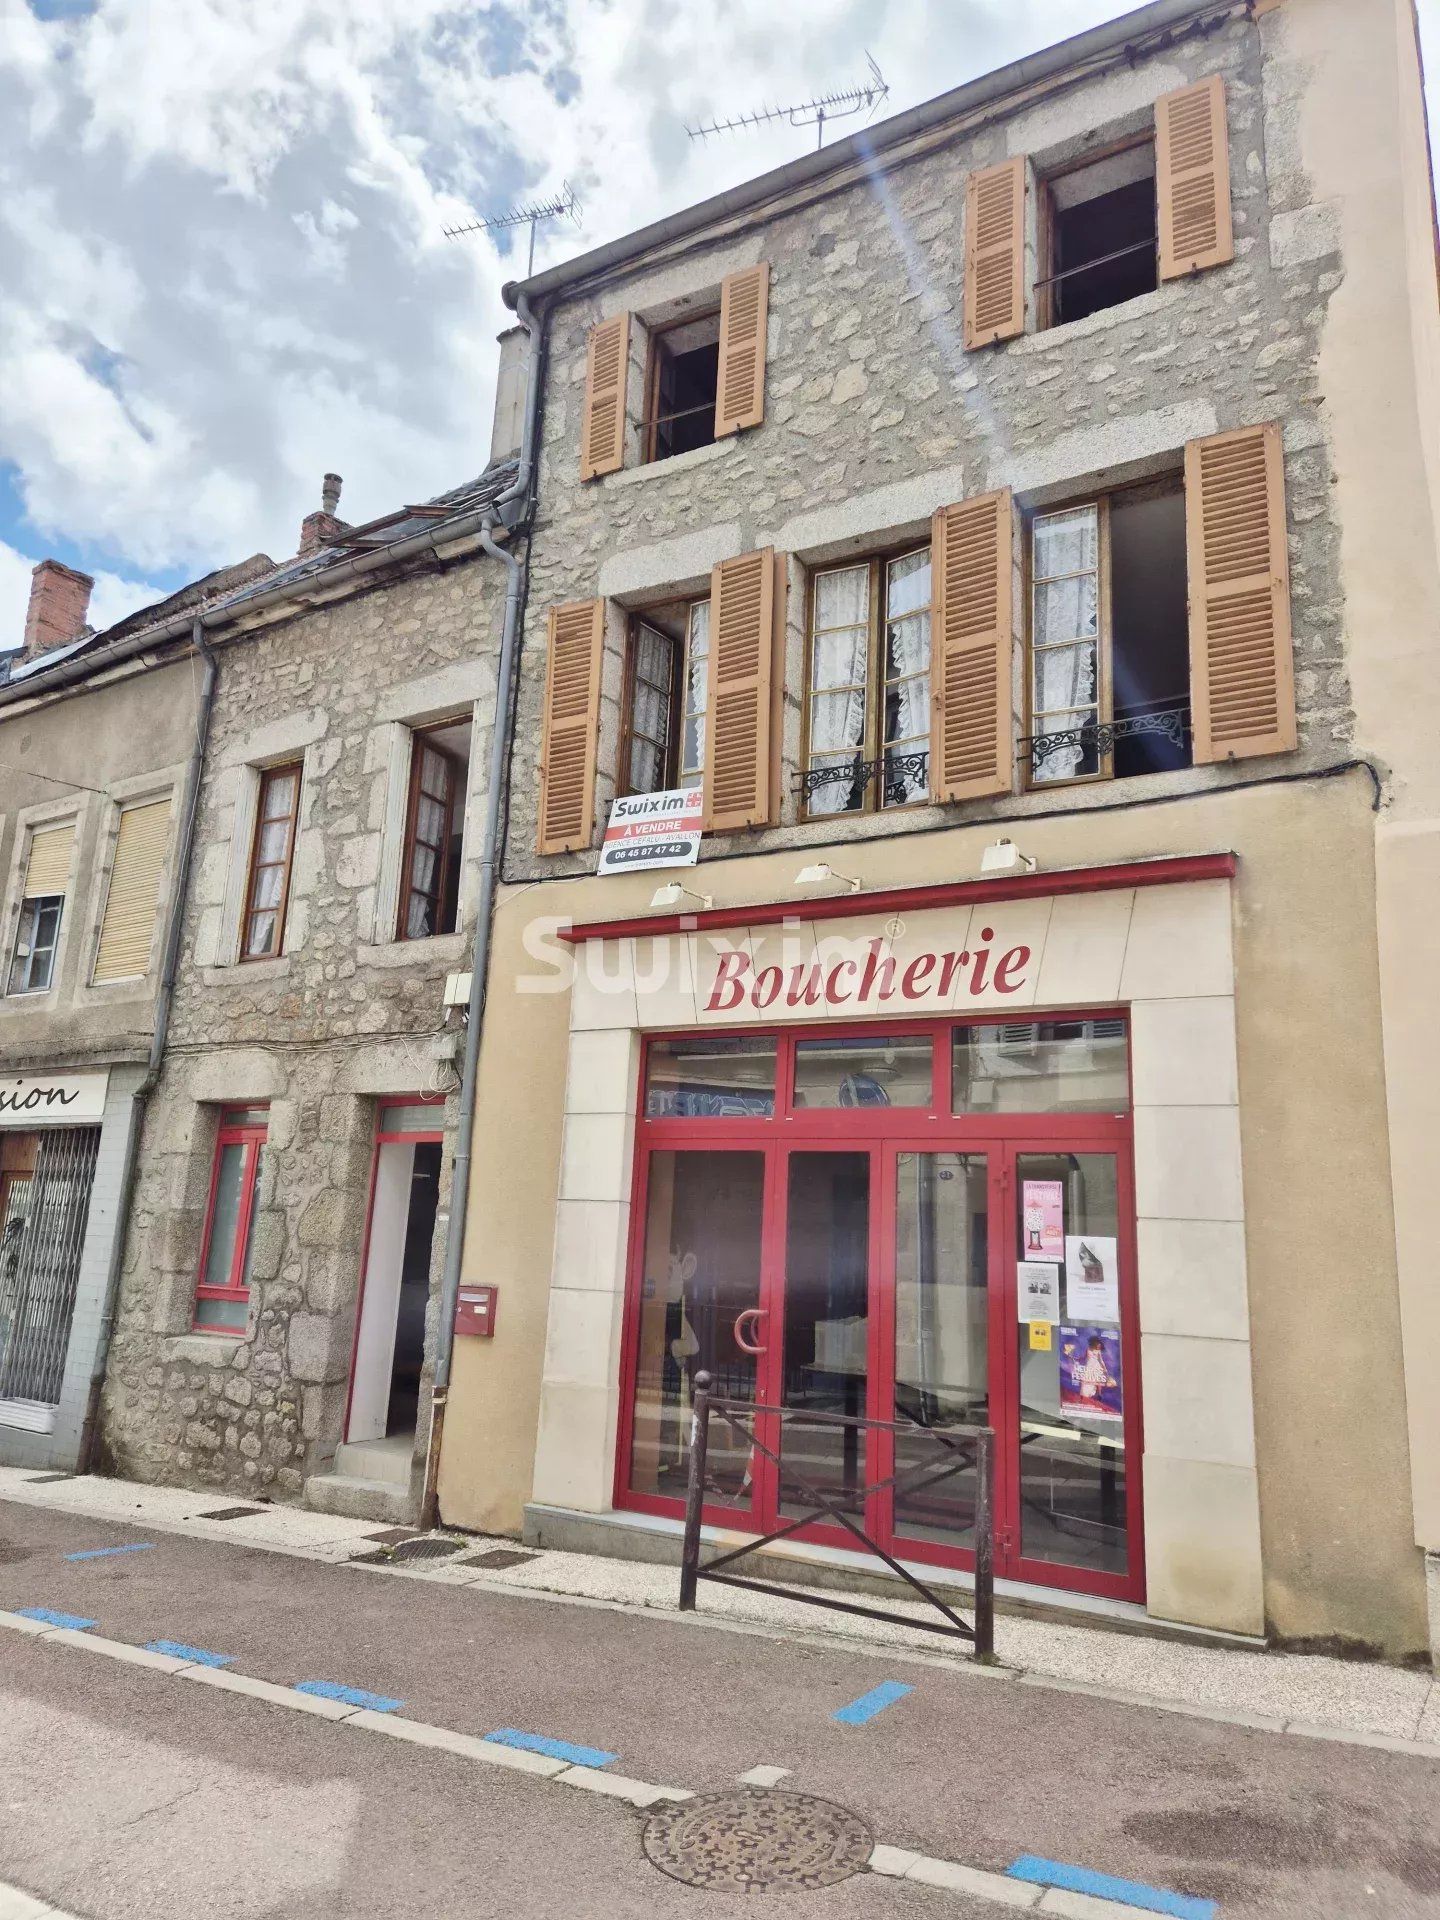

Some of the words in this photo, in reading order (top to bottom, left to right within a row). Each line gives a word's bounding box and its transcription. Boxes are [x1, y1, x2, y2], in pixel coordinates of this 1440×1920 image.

[615, 796, 684, 818] Swixim
[635, 820, 682, 833] VENDRE
[666, 832, 700, 841] AVALLON
[615, 851, 626, 860] 06
[627, 849, 639, 858] 45
[641, 847, 652, 856] 87
[654, 846, 666, 854] 47
[668, 845, 682, 853] 42
[703, 927, 1031, 1011] Boucherie
